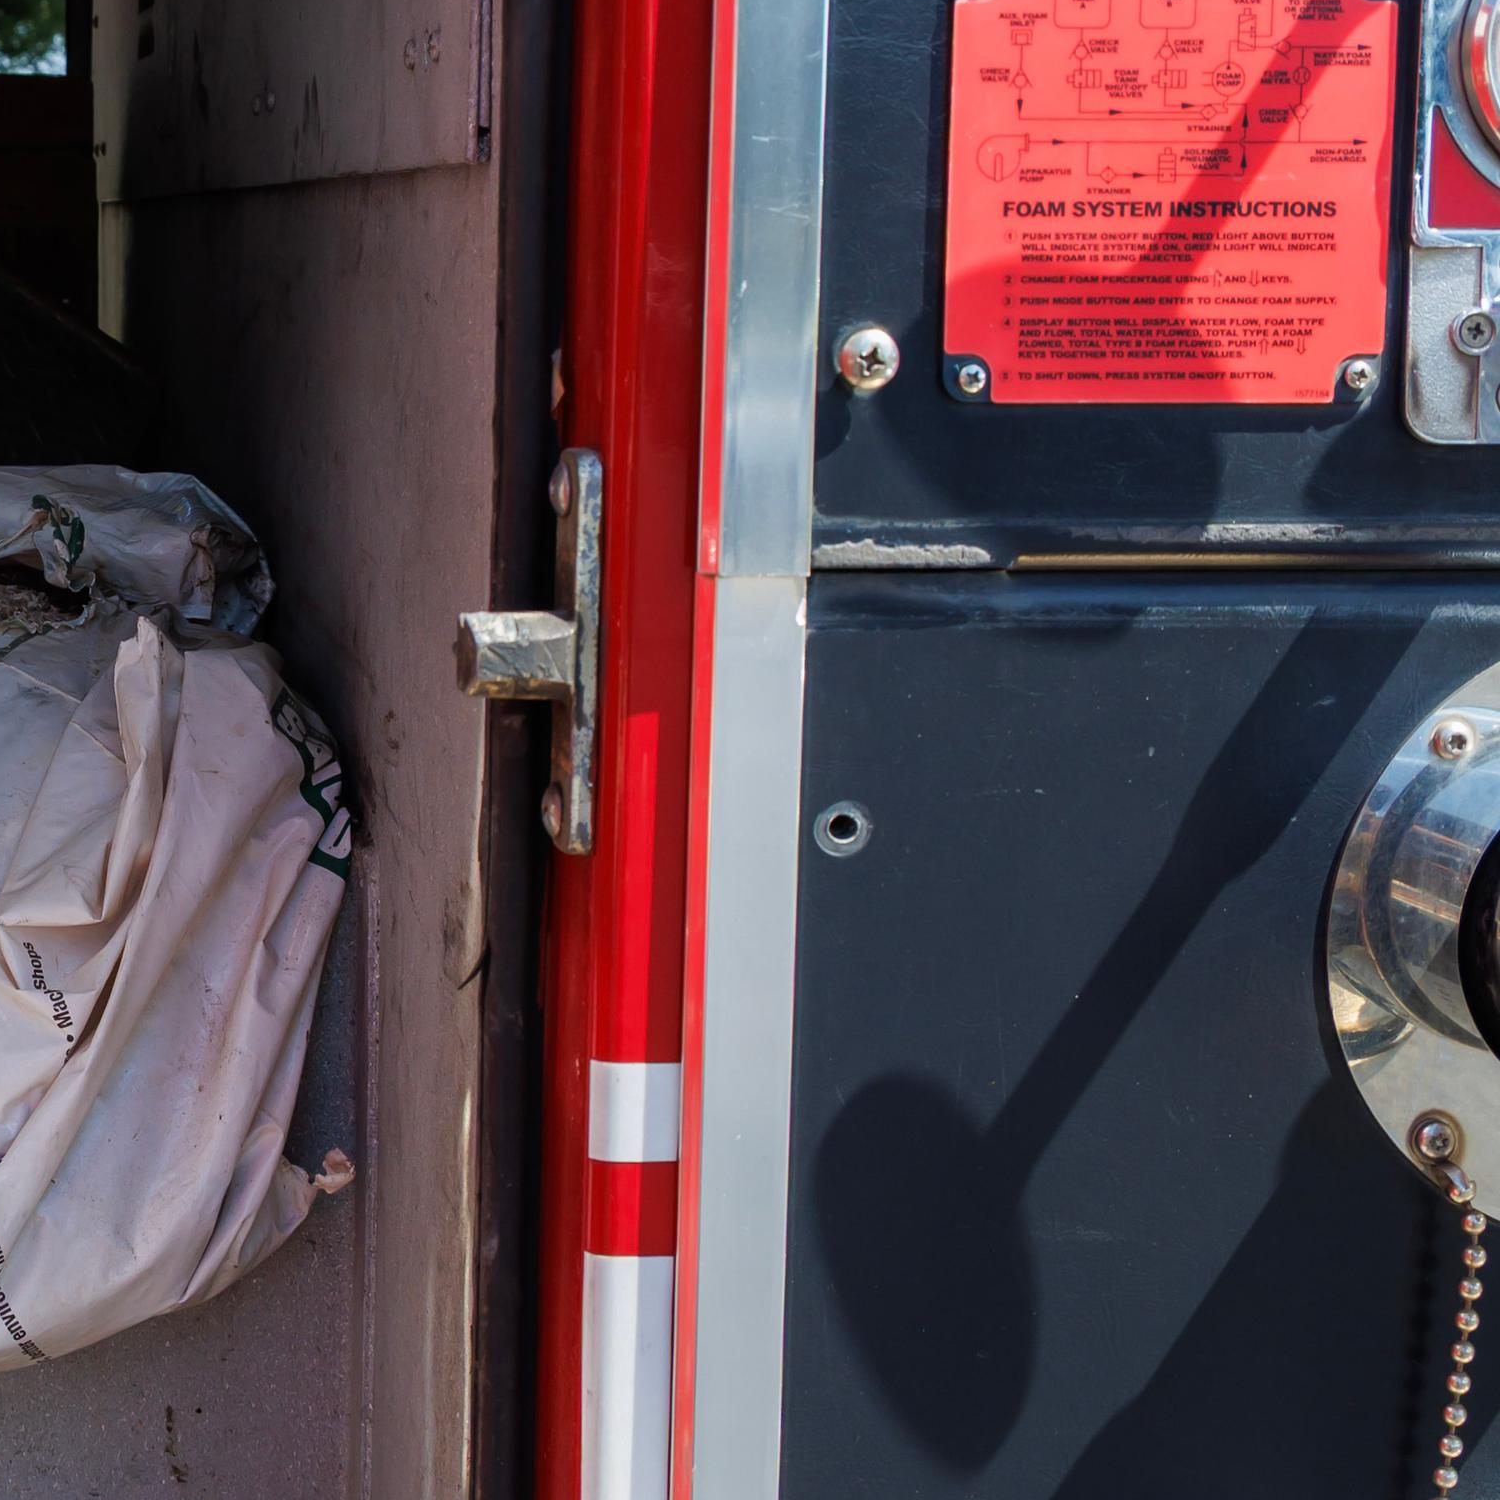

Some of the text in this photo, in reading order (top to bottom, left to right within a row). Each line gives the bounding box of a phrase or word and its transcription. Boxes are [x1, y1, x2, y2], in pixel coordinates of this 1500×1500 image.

[1314, 59, 1371, 67] DISCHARGES
[1003, 201, 1337, 217] FOAM SYSTEM INSTRUCTIONS
[1022, 232, 1052, 240] PUSH
[1055, 232, 1097, 240] SYSTEM
[1100, 232, 1139, 240] ON/OFF
[1192, 232, 1214, 240] RED
[1216, 232, 1249, 240] LIGHT
[1252, 232, 1287, 240] ABOVE
[1291, 232, 1334, 240] BUTTON
[1021, 244, 1047, 252] WILL
[1050, 244, 1100, 252] INDICATE
[1103, 244, 1146, 252] SYSTEM
[1149, 244, 1159, 252] IS
[1185, 244, 1220, 252] GREEN
[1223, 244, 1256, 252] LIGHT
[1259, 244, 1284, 252] WILL
[1287, 244, 1337, 252] INDICATE
[1021, 254, 1053, 262] WHEN
[1056, 254, 1086, 262] FOAM
[1090, 254, 1099, 262] IS
[1103, 254, 1136, 262] BEING
[1020, 276, 1066, 284] CHANGE
[1068, 276, 1099, 284] FOAM
[1102, 276, 1172, 284] PERCENTAGE
[1175, 276, 1209, 284] USING
[1224, 276, 1246, 284] AND
[1262, 276, 1293, 284] KEYS.
[1019, 372, 1033, 380] TO
[1036, 372, 1065, 380] SHUT
[1105, 372, 1139, 380] PRESS
[1143, 372, 1186, 380] SYSTEM
[1188, 372, 1227, 380] ON/OFF
[1230, 372, 1276, 380] BUTTON.
[23, 941, 46, 990] Shops
